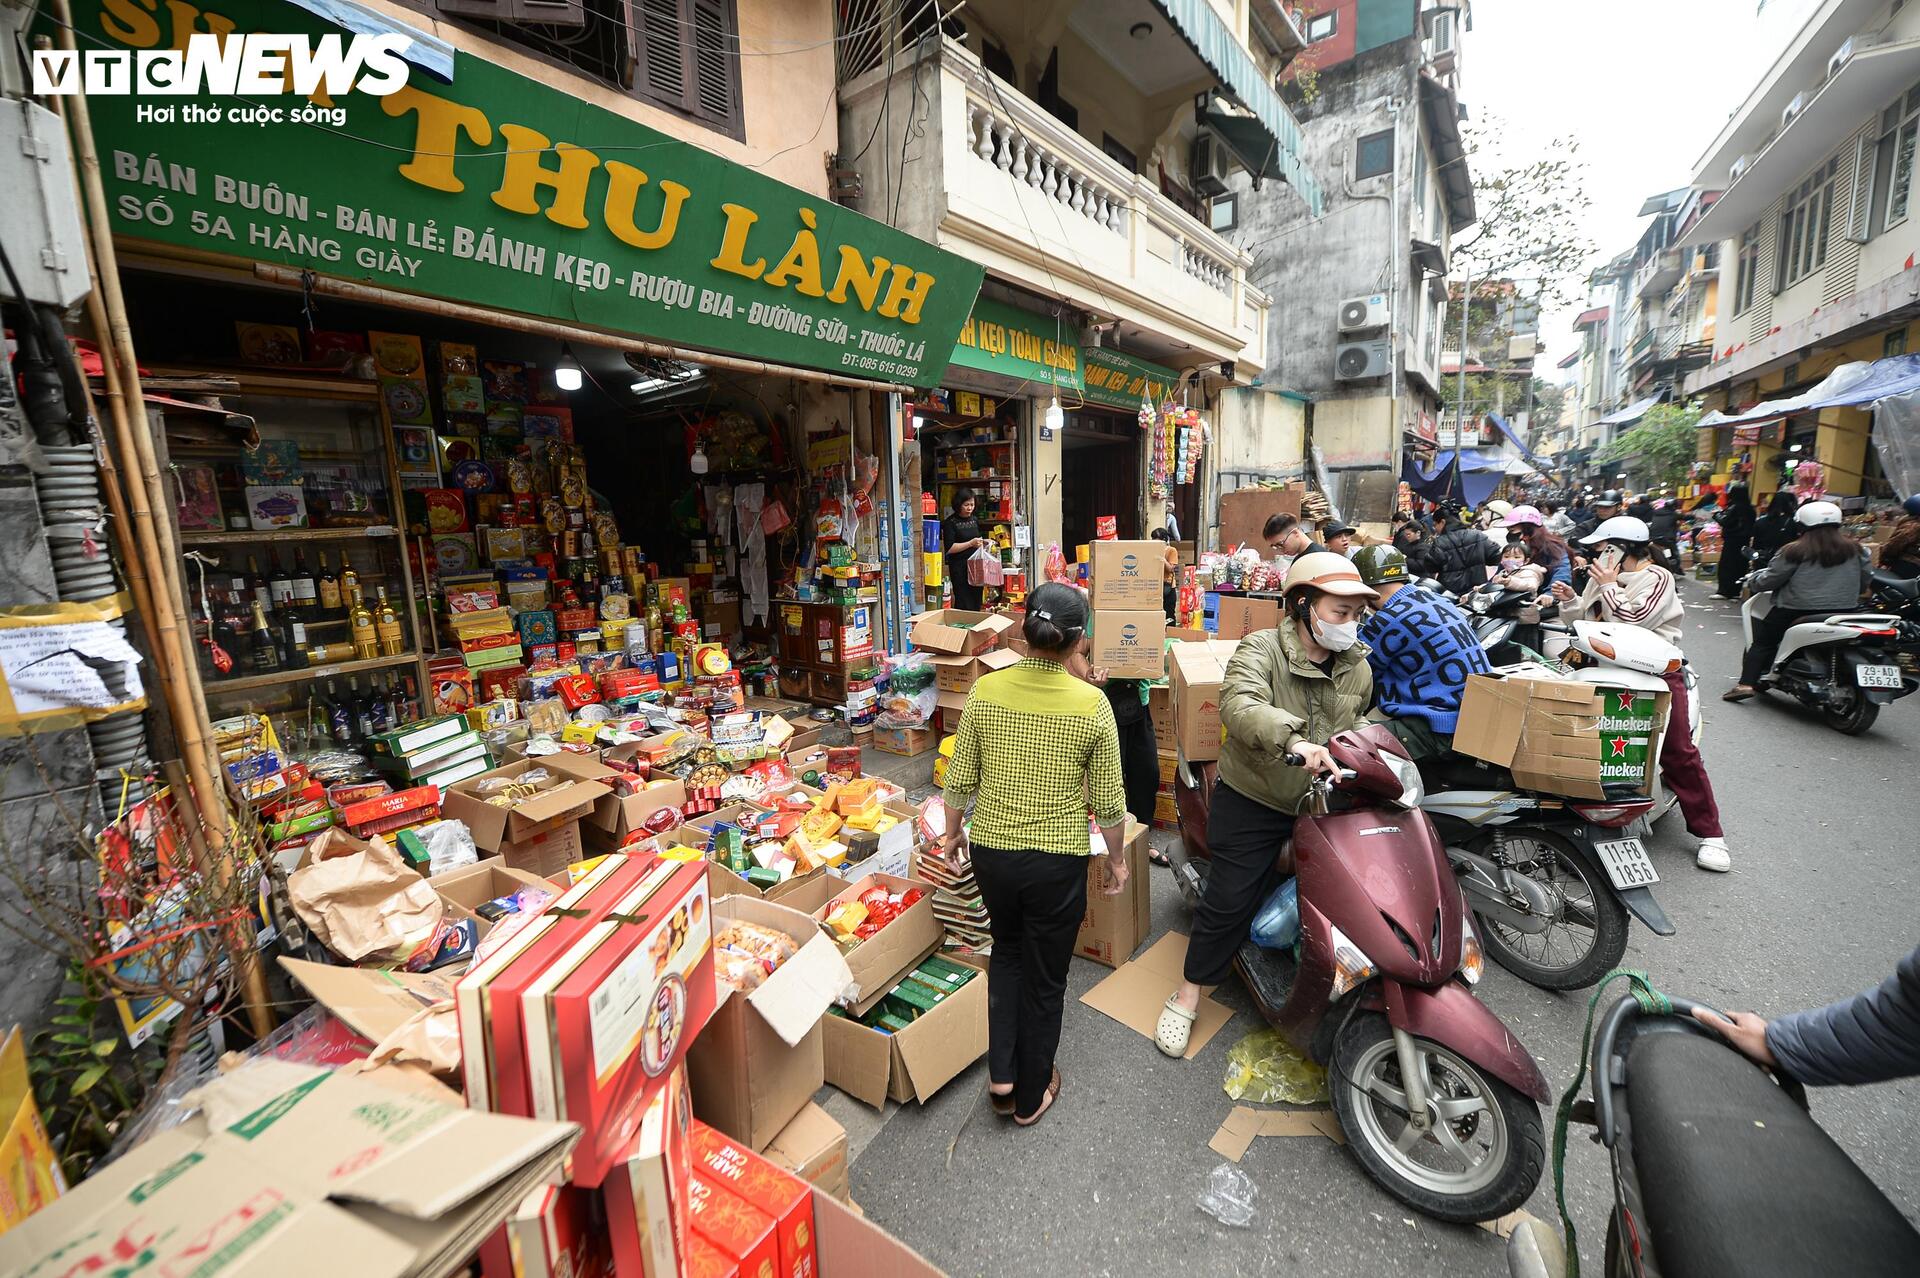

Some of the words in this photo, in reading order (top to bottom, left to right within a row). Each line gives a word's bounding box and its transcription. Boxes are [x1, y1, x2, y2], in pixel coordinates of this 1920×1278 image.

[381, 84, 692, 250] THU
[710, 207, 936, 325] LÀNH
[118, 194, 174, 226] SỐ
[191, 210, 236, 240] 5A
[249, 223, 342, 262] HÀNG
[355, 247, 423, 278] GIÀY
[114, 150, 197, 195] BÁN
[214, 174, 308, 221] BUÔN
[336, 204, 397, 242] BÁN
[407, 219, 445, 253] LẺ:
[452, 225, 546, 276] BÁNH
[554, 252, 611, 292] KẸO
[629, 270, 695, 311] RƯỢU
[697, 288, 734, 319] BIA
[747, 301, 813, 337] ĐƯỜNG
[815, 317, 849, 345] SỮA
[858, 329, 906, 358] THUỐC
[905, 340, 927, 362] LÁ
[979, 320, 1005, 358] KẸO
[1008, 328, 1041, 363] TOÀN
[859, 356, 878, 370] 085
[878, 360, 895, 374] 615
[896, 363, 918, 378] 0299
[1861, 676, 1900, 687] 356.26
[1600, 762, 1645, 777] eineken
[381, 795, 409, 809] MARIA
[386, 804, 405, 812] CAKE
[1615, 862, 1653, 885] 1856
[704, 1150, 745, 1181] MARIA
